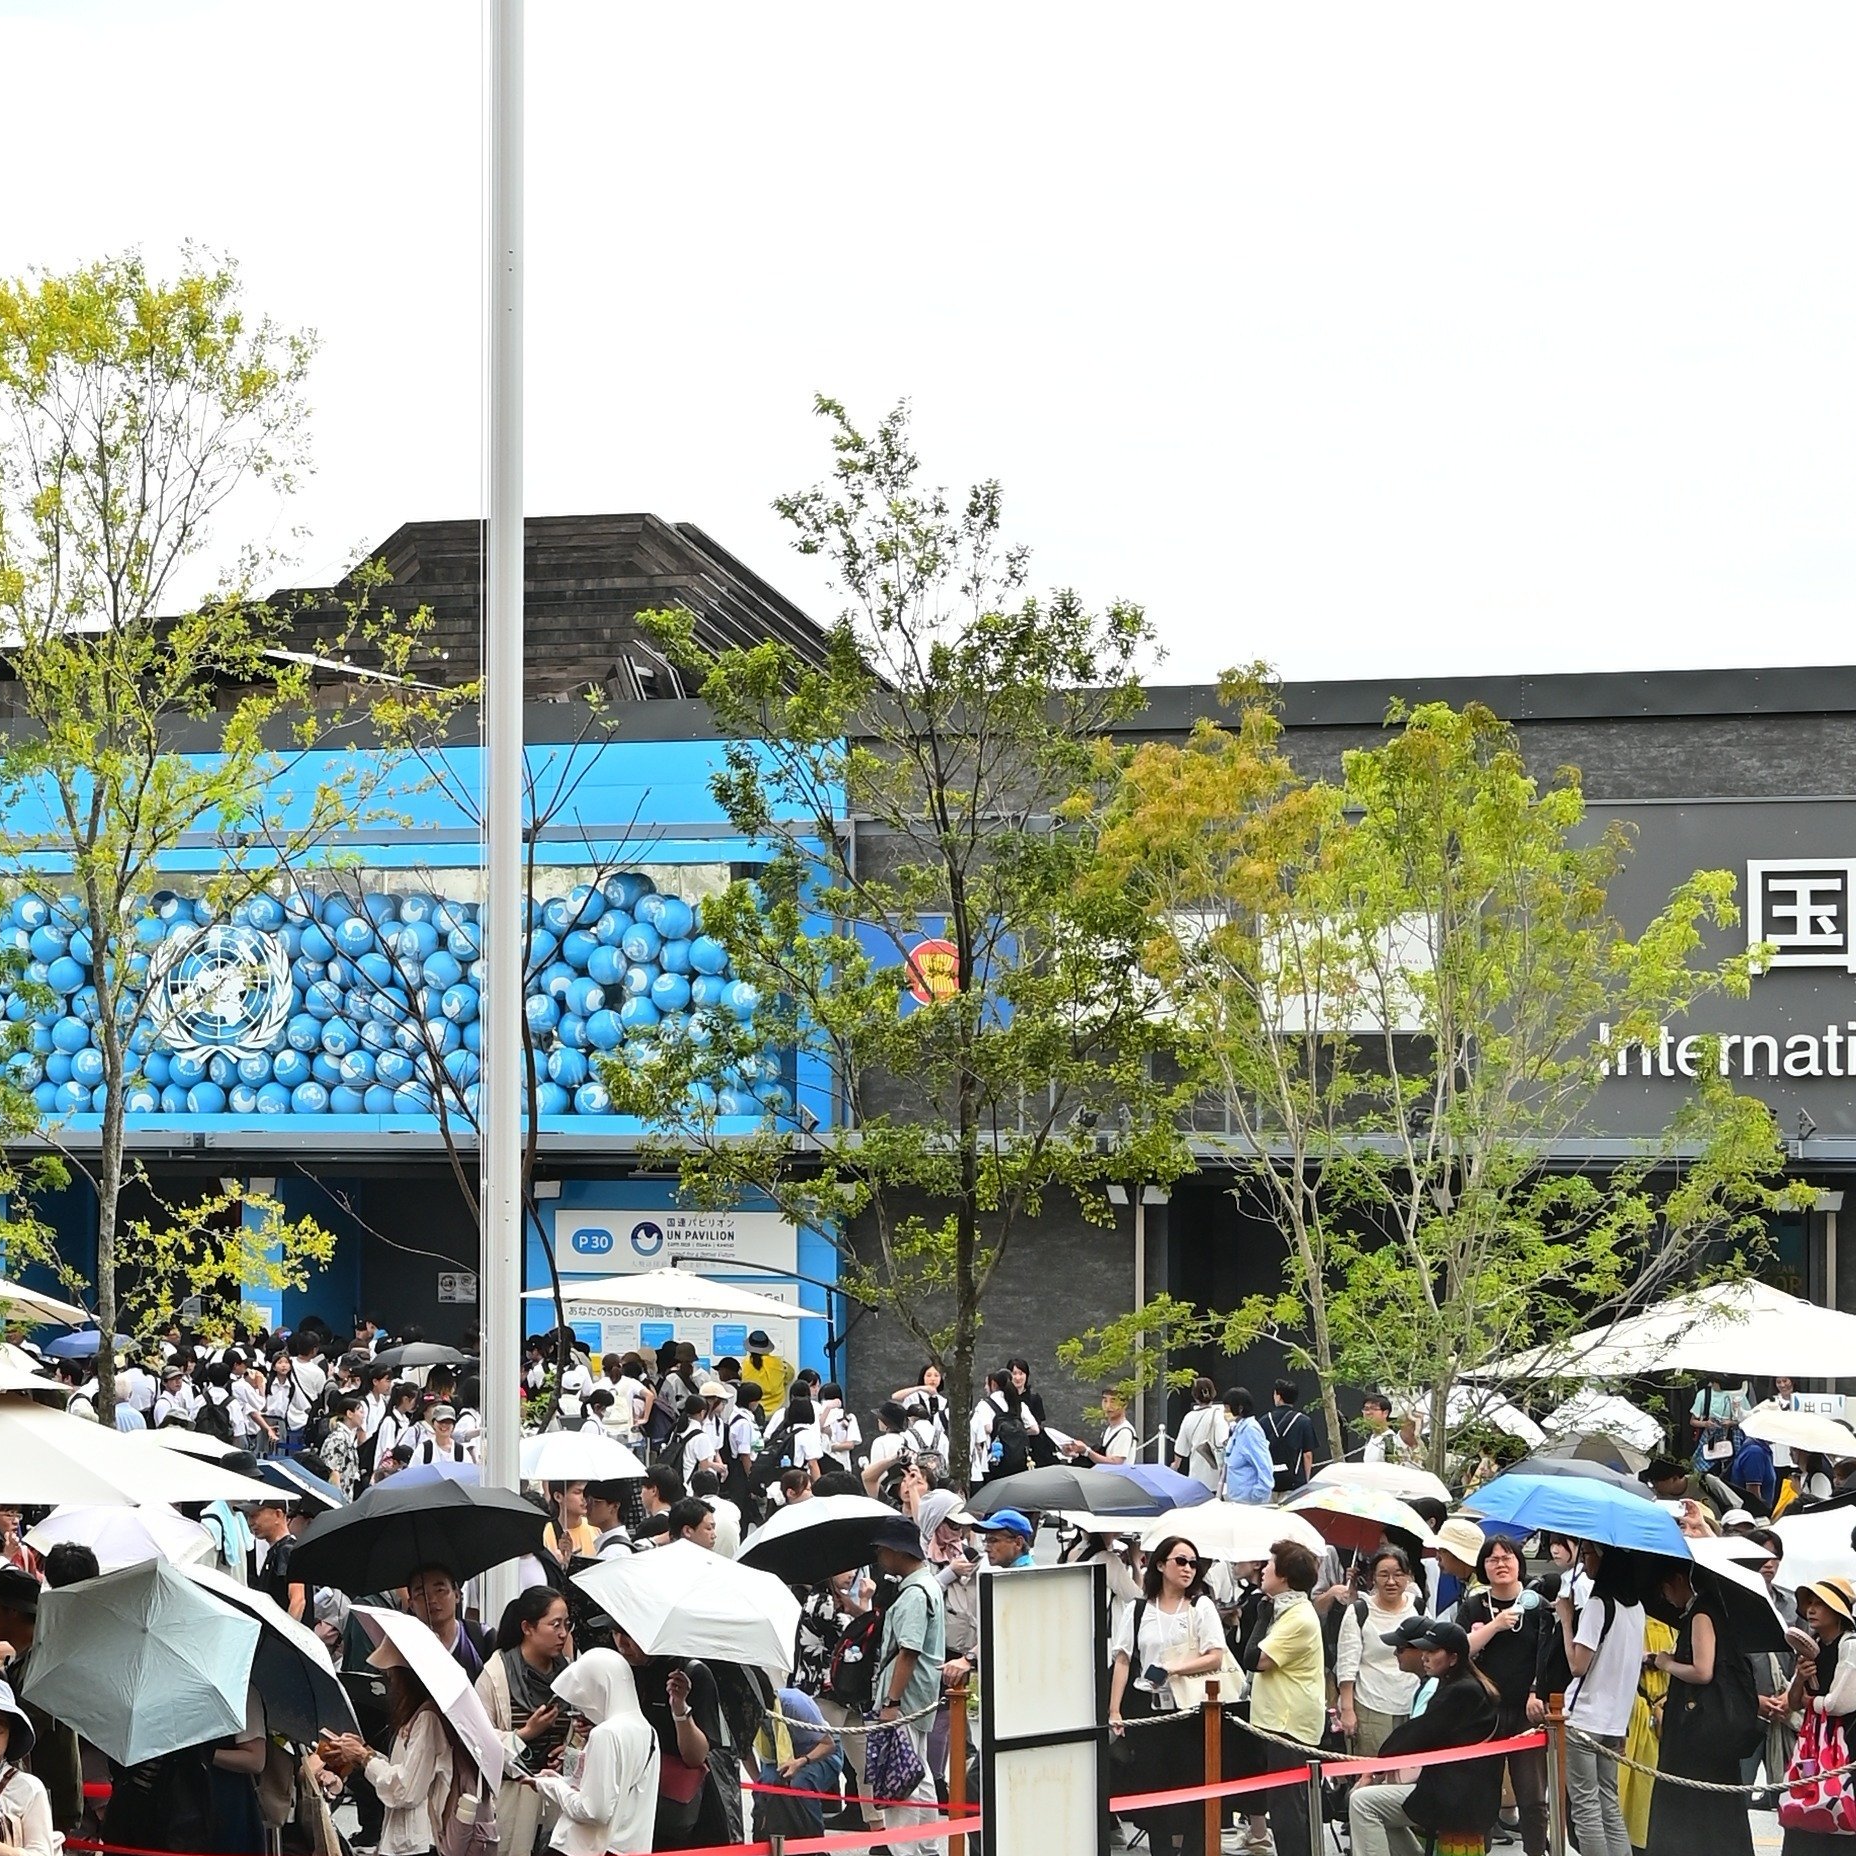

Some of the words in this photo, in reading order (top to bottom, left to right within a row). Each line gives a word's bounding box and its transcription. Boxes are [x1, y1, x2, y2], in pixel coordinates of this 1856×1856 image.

[1747, 858, 1856, 974] 国
[666, 1230, 681, 1240] UN
[685, 1231, 735, 1241] PAVILION
[1804, 1401, 1832, 1414] 出口
